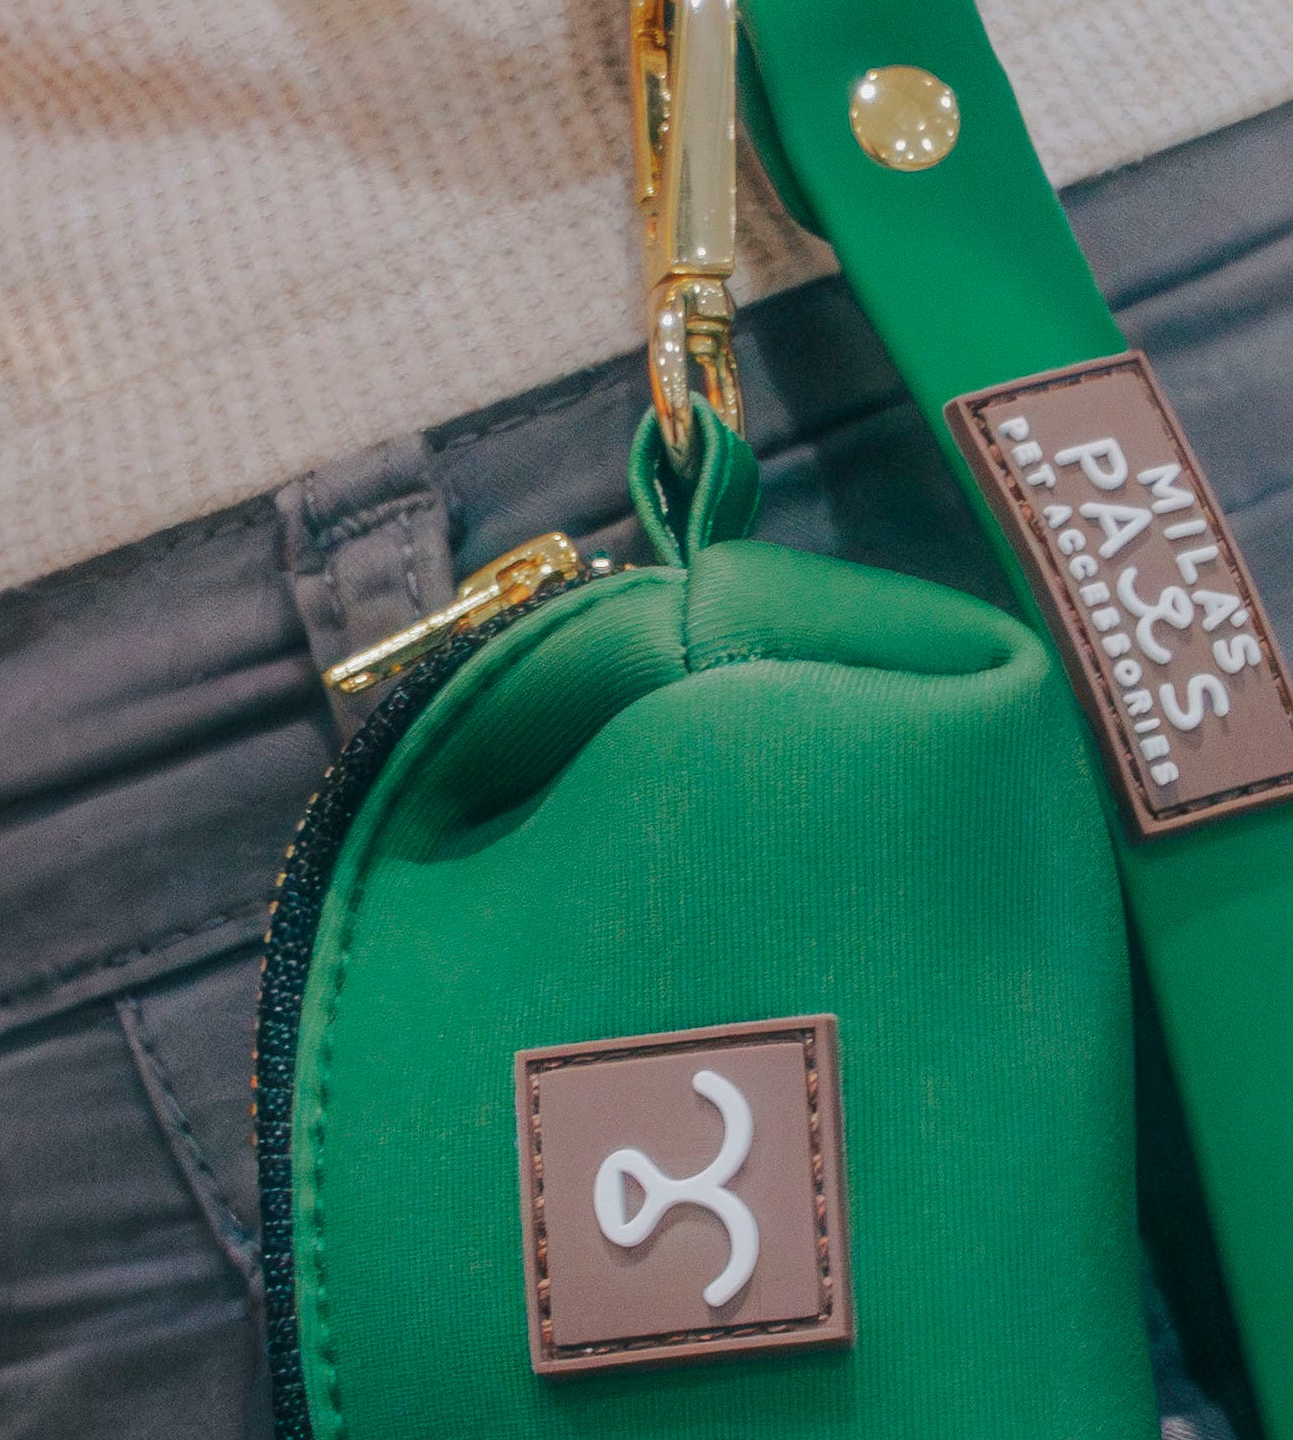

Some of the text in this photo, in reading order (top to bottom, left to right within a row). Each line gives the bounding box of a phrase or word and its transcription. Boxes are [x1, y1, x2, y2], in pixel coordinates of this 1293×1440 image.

[998, 417, 1181, 787] PET ACCESSORIES
[1137, 463, 1262, 676] MILA'S
